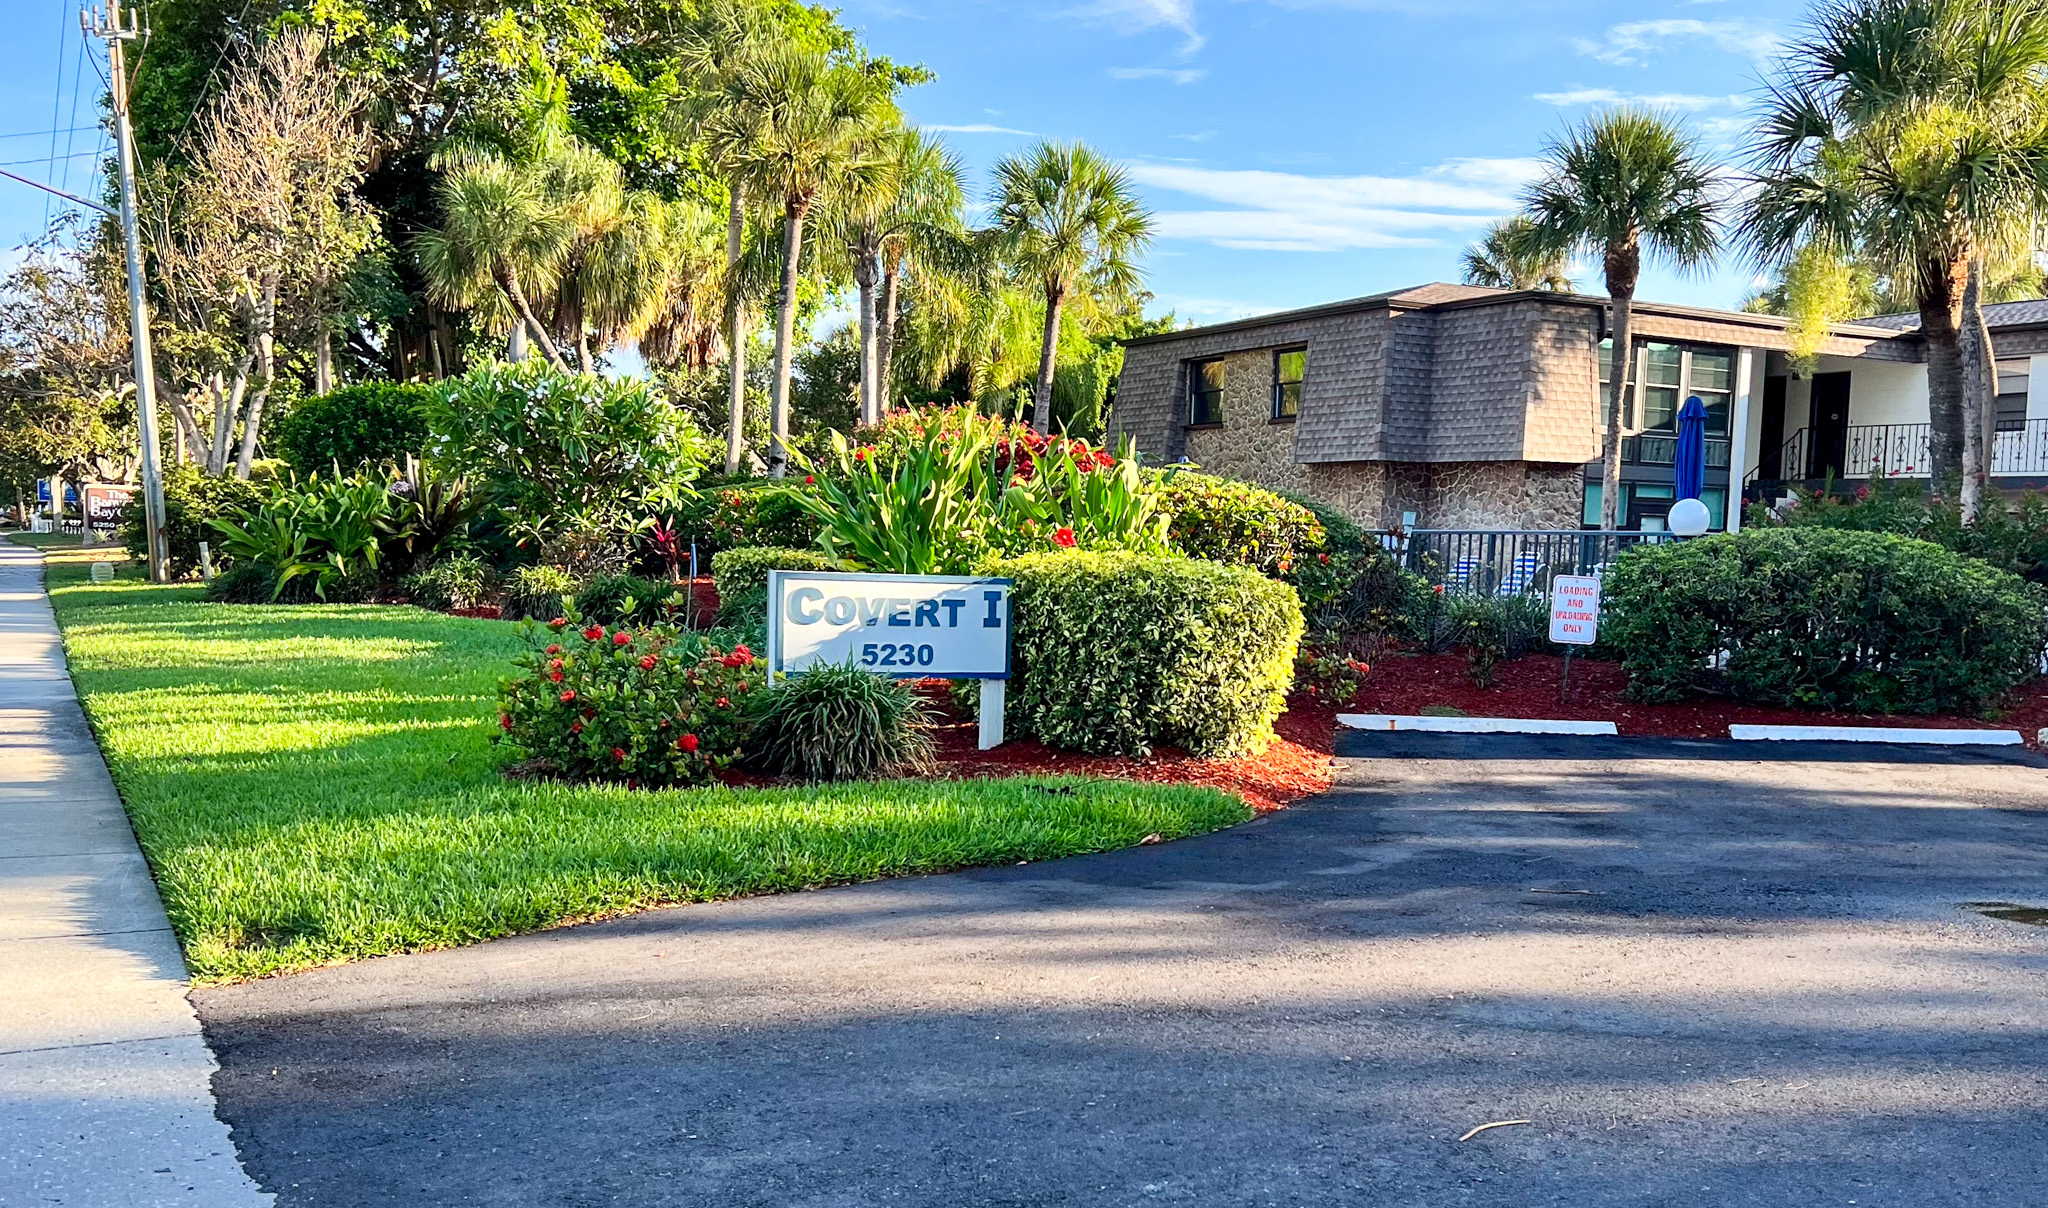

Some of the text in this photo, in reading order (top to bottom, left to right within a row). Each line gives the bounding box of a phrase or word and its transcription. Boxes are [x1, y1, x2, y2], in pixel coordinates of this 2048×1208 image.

[106, 490, 128, 499] The
[1559, 586, 1593, 596] LOADING
[785, 587, 1002, 628] COVERT I
[1567, 599, 1584, 608] AND
[1555, 611, 1593, 621] UNLOADING
[1563, 624, 1582, 633] ONLY
[861, 643, 934, 666] 5230
